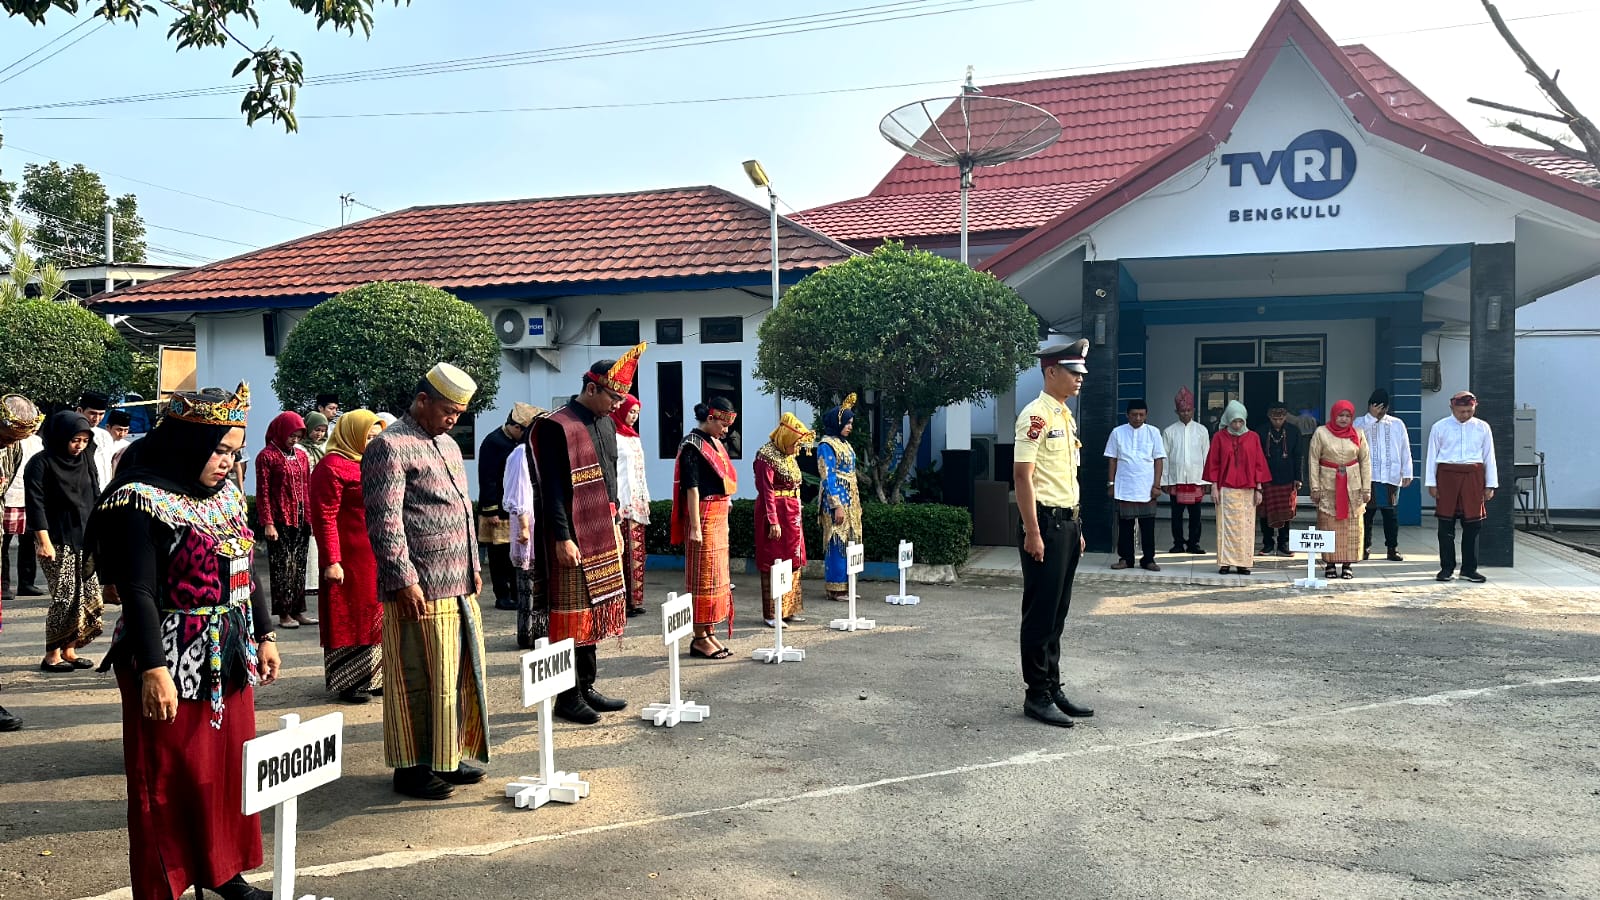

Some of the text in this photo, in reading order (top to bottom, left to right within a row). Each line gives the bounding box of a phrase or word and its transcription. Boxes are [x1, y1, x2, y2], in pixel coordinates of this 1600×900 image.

[1221, 147, 1343, 187] TVRI
[1229, 204, 1341, 222] BENGKULU
[667, 606, 691, 634] BERITA
[529, 648, 571, 684] TEKNIK
[257, 733, 336, 792] PROGRAM
